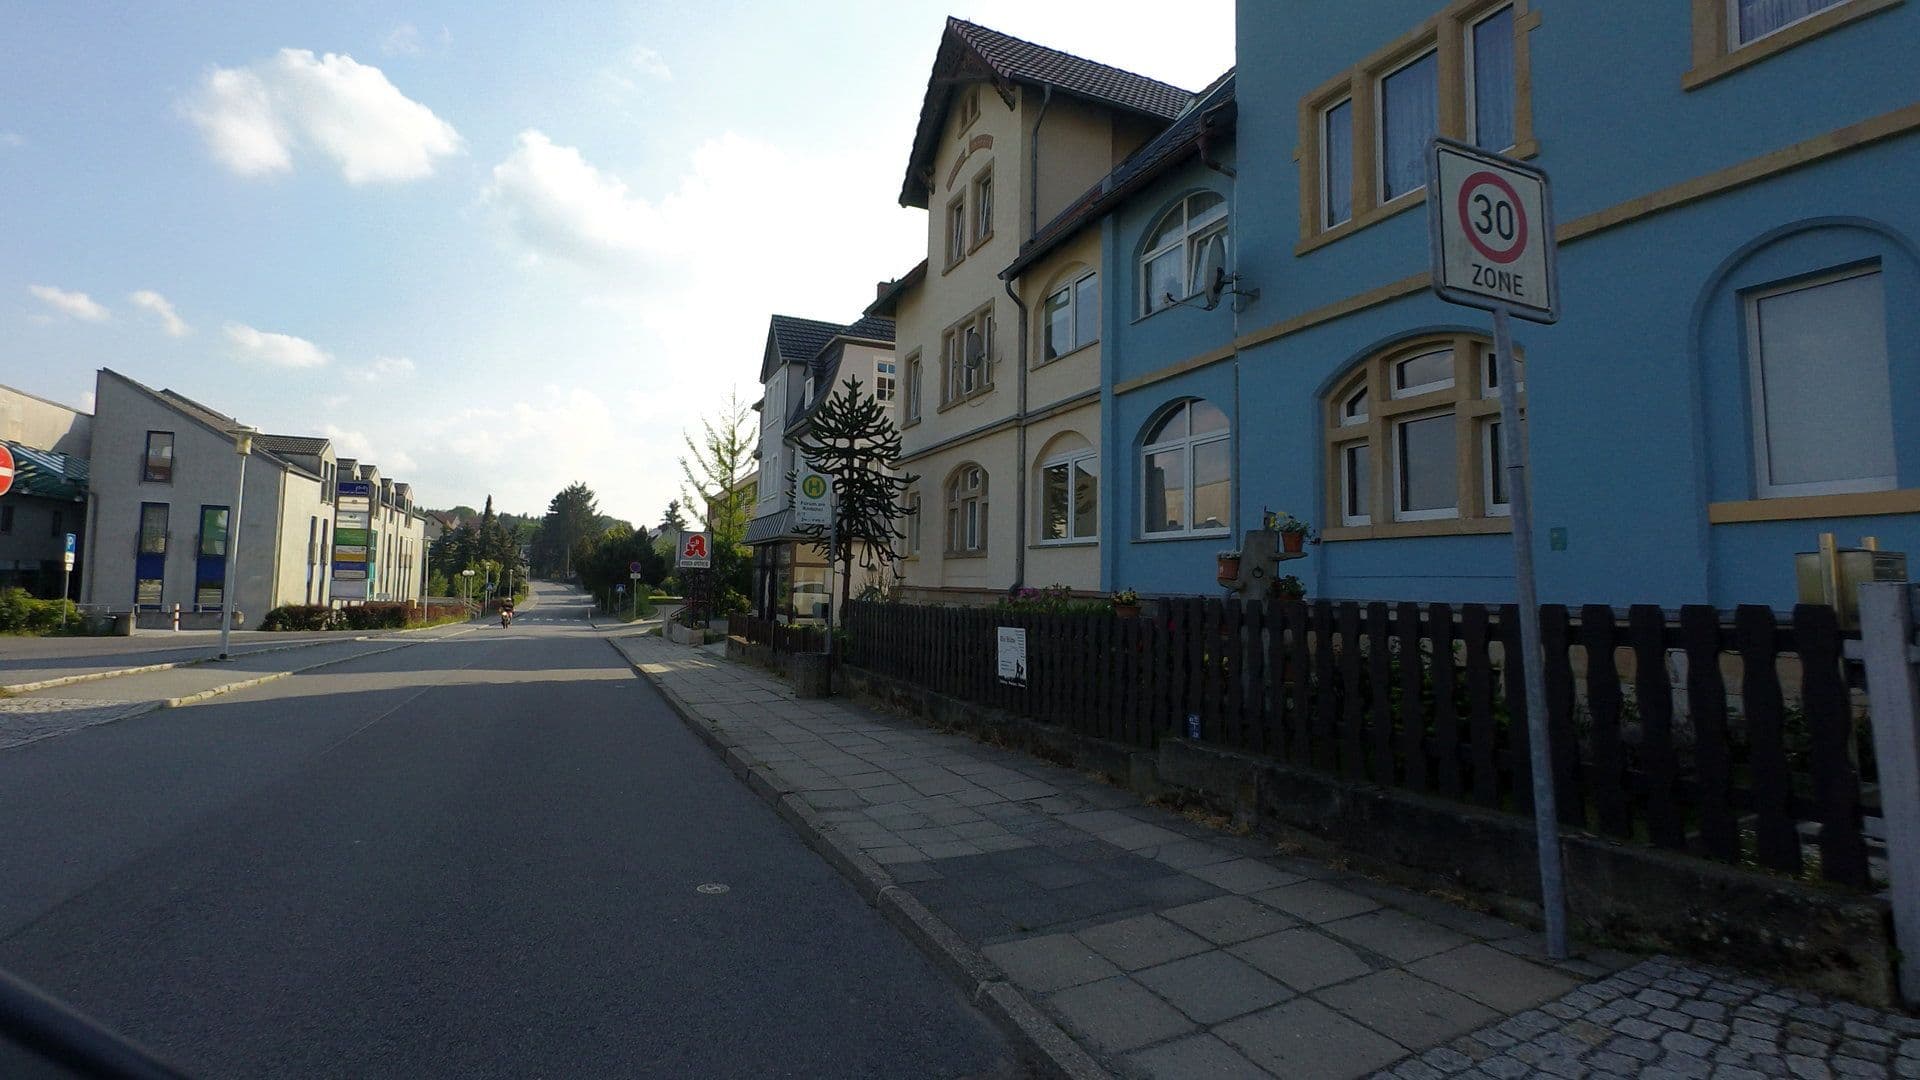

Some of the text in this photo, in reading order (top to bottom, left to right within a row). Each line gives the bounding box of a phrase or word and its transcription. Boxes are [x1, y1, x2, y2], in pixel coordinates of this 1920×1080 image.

[1473, 194, 1513, 240] 30
[1471, 264, 1524, 296] ZONE
[808, 479, 819, 493] H
